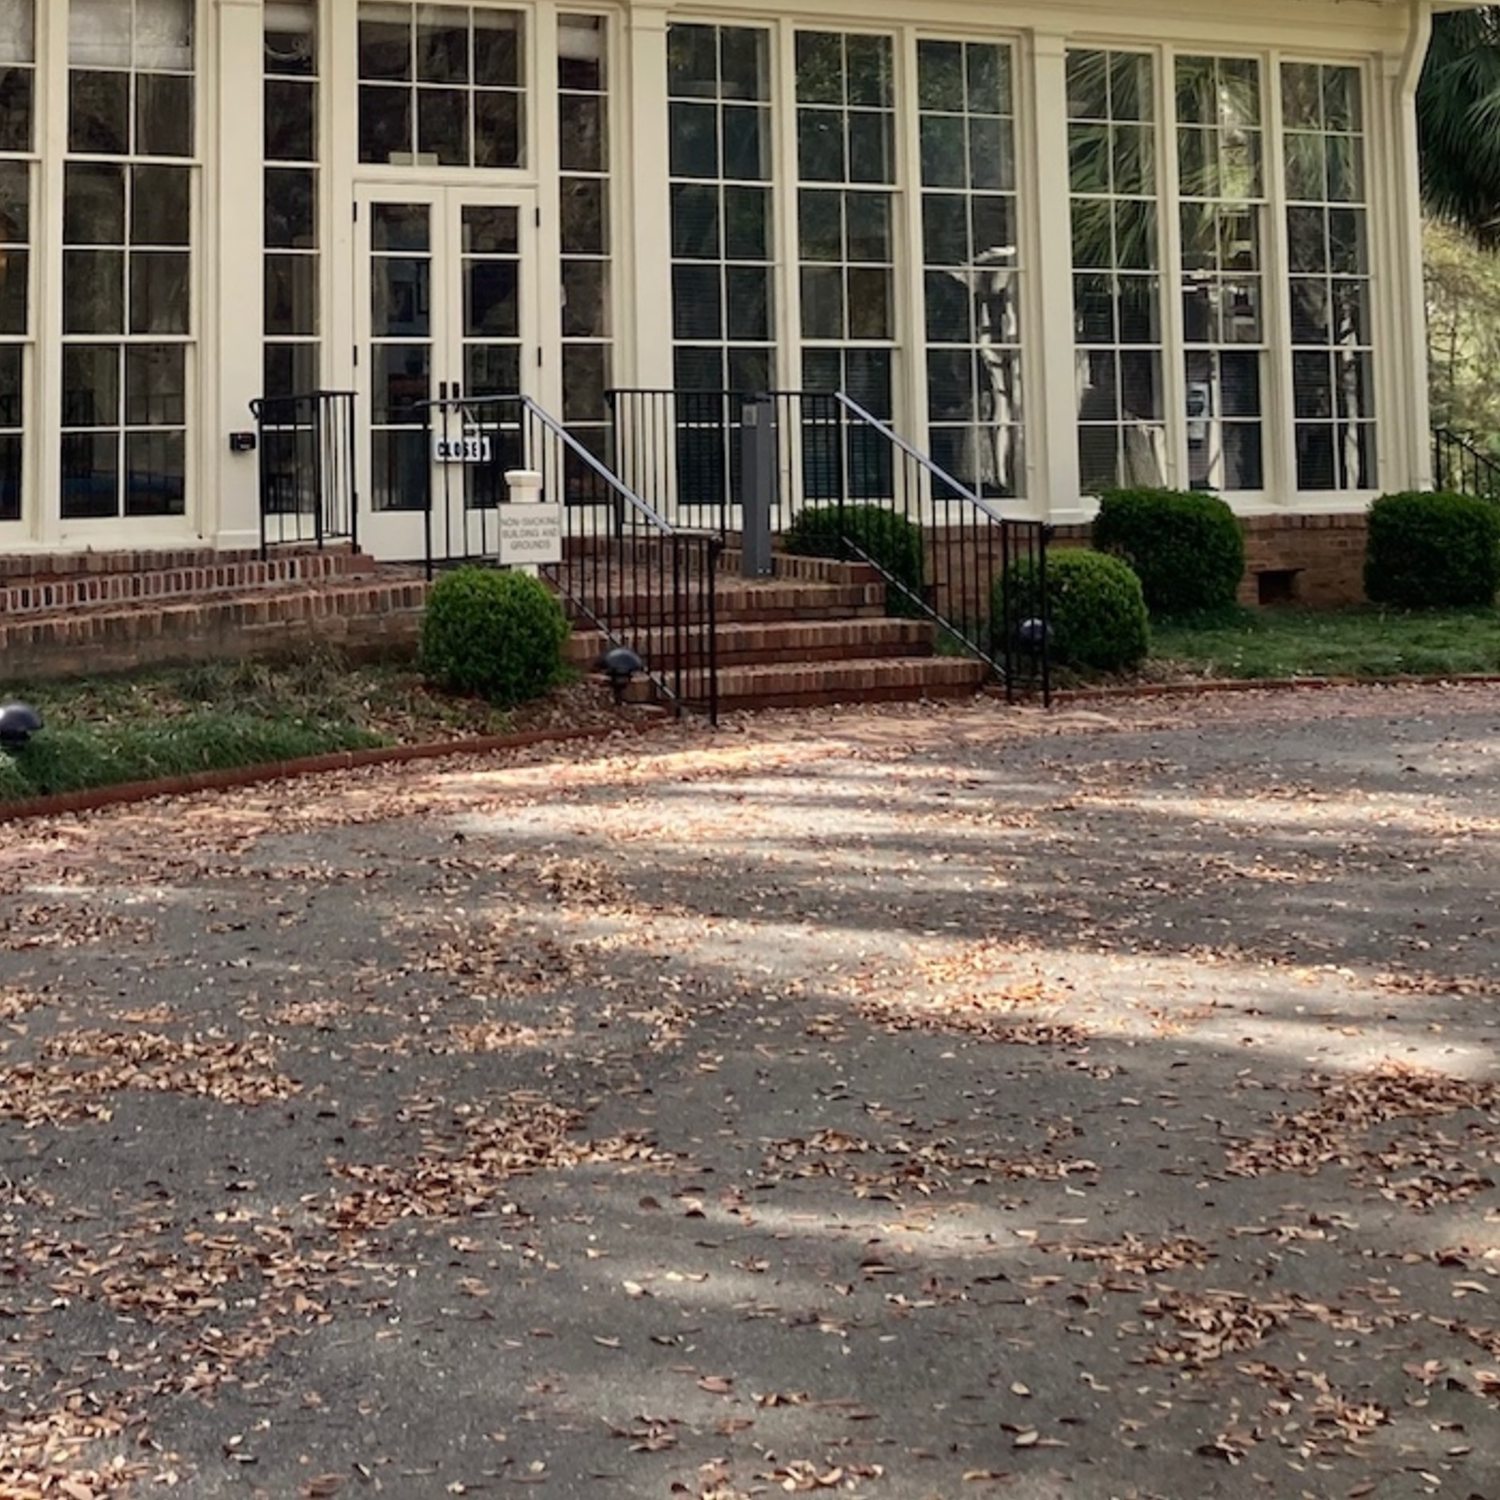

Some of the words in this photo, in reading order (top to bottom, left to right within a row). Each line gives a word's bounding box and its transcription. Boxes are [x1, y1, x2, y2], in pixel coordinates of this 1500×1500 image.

[438, 441, 486, 458] CLOSED
[502, 527, 540, 538] BUILDING
[542, 526, 557, 537] AND
[511, 538, 551, 550] GROUNDS
